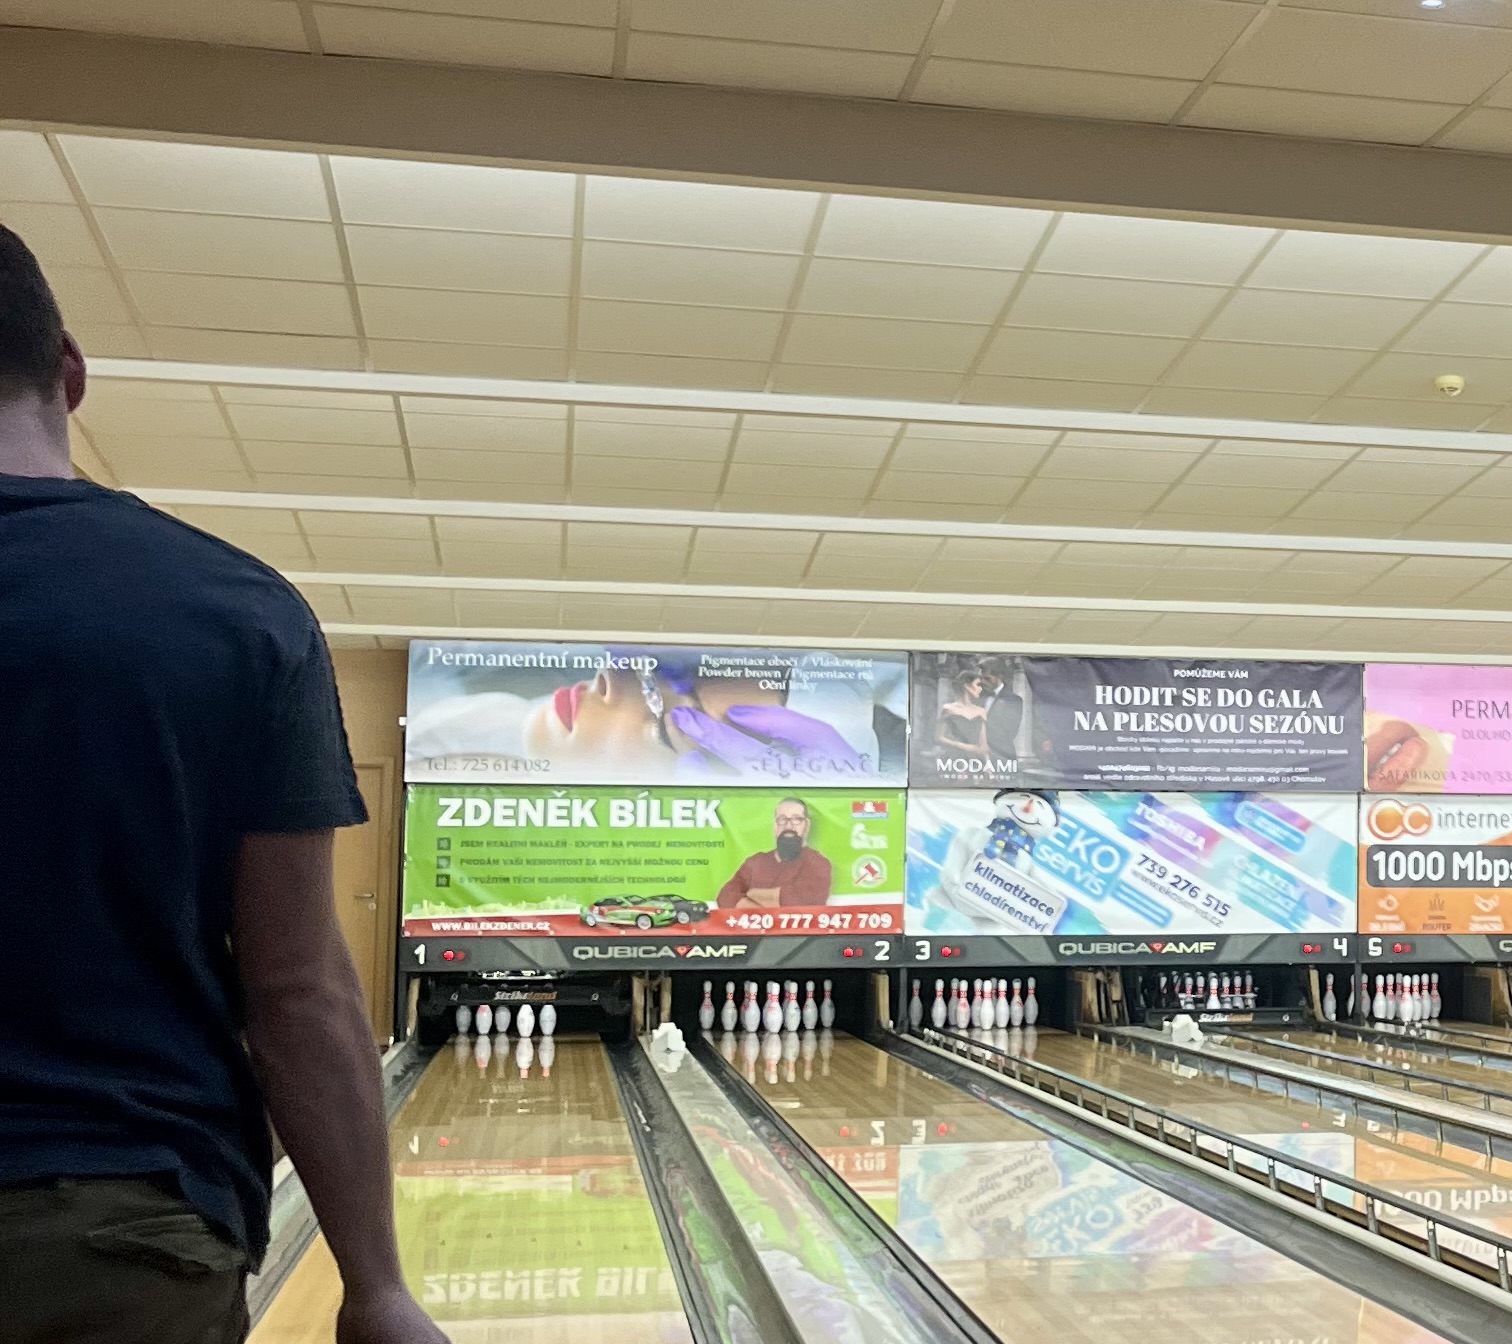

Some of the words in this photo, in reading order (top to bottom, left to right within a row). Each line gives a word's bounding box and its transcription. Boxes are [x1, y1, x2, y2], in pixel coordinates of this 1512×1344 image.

[428, 646, 569, 669] Permanentní
[572, 652, 659, 676] makeup
[698, 667, 742, 678] Powder
[744, 667, 781, 678] brown
[700, 655, 765, 668] Pigmentace
[1173, 667, 1224, 678] POMŮŽEME
[1227, 668, 1249, 679] VÁM
[758, 679, 786, 690] Oční
[1094, 684, 1176, 708] HODIT
[1181, 686, 1212, 709] SE
[1215, 687, 1253, 710] DO
[1257, 688, 1323, 710] GALA
[1074, 710, 1109, 732] NA
[1112, 710, 1245, 734] PLESOVOU
[1248, 710, 1345, 736] SEZÓNU
[462, 758, 490, 772] 725
[493, 758, 520, 772] 614
[523, 758, 551, 773] 082
[935, 757, 1018, 774] MODAMI
[436, 790, 599, 829] ZDENĚK
[609, 792, 725, 829] BÍLEK
[1135, 801, 1206, 851] TOSHIBA
[1047, 816, 1121, 874] EKO
[1034, 843, 1107, 897] servis
[1372, 849, 1446, 882] 1000
[974, 861, 1055, 917] klimatizace
[1137, 854, 1168, 879] 739
[1169, 874, 1201, 899] 276
[1202, 893, 1232, 917] 515
[964, 881, 1049, 933] chladírenství
[726, 914, 774, 929] +420
[778, 914, 814, 929] 777
[817, 913, 853, 929] 947
[857, 913, 893, 929] 709
[413, 943, 426, 965] 1
[874, 941, 890, 961] 2
[914, 940, 931, 960] 3
[1332, 937, 1349, 957] 4
[1367, 936, 1383, 956] 5
